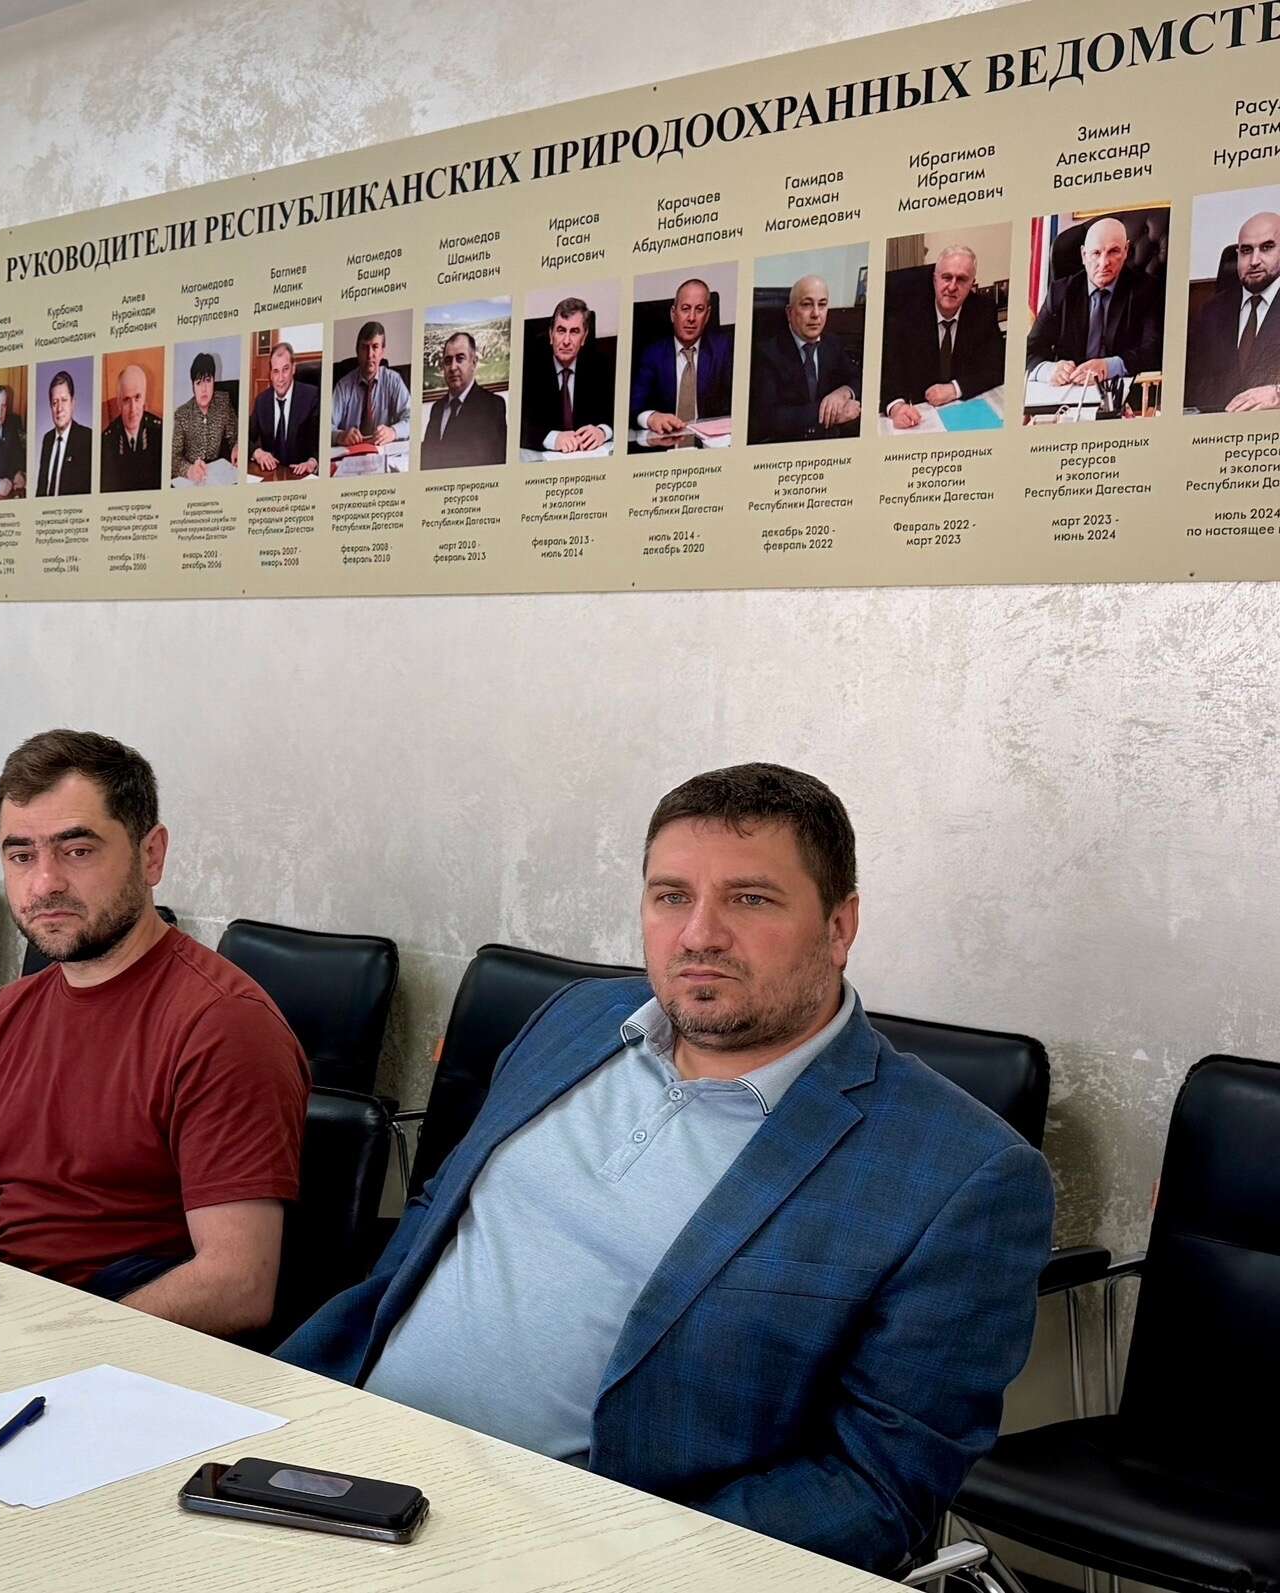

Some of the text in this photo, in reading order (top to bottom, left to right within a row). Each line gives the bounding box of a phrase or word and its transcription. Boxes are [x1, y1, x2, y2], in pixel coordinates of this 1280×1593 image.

[1235, 98, 1280, 116] Расу
[1077, 122, 1131, 142] Зимин
[909, 145, 996, 170] Ибрагимов
[1055, 141, 1151, 167] Александр
[6, 219, 197, 282] РУКОВОДИТЕЛИ
[205, 151, 520, 243] РЕСПУБЛИКАНСКИХ
[532, 60, 970, 179] ПРИРОДООХРАННЫХ
[916, 168, 986, 189] Ибрагим
[1053, 163, 1152, 189] Васильевич
[784, 170, 844, 190] Гамидов
[656, 191, 721, 213] Карачаев
[787, 191, 840, 209] Рахман
[897, 186, 1004, 212] Магомедович
[548, 212, 600, 233] Идрисов
[657, 211, 719, 231] Набиюла
[764, 208, 861, 233] Магомедович
[438, 230, 501, 250] Магомедов
[555, 232, 591, 248] Гасан
[631, 226, 744, 254] Абдулманапович
[345, 247, 403, 266] Магомедов
[447, 250, 492, 266] Шамиль
[540, 248, 605, 270] Идрисович
[356, 266, 391, 281] Башир
[436, 265, 501, 285] Сайгидович
[180, 277, 235, 294] Магомедова
[272, 281, 304, 295] Малик
[340, 281, 408, 301] Ибрагимович
[193, 295, 220, 311] Зухра
[252, 294, 323, 316] Джамединович
[176, 308, 240, 327] Насруллаевна
[1029, 437, 1150, 455] министр природных
[1191, 431, 1280, 447] министр прир
[883, 447, 993, 463] министр природных
[1059, 455, 1117, 470] ресурсов
[1224, 447, 1278, 462] ресурсо
[752, 456, 852, 472] министр природных
[911, 464, 963, 478] ресурсов
[1219, 466, 1227, 475] и
[632, 465, 723, 480] министр природных
[777, 472, 825, 486] ресурсов
[1055, 470, 1120, 482] и экологии
[654, 480, 698, 494] ресурсов
[773, 486, 828, 497] и экологии
[907, 478, 966, 489] и экологии
[1185, 477, 1260, 494] Республики
[658, 493, 700, 504] экологии
[878, 490, 994, 507] Республики Дагестан
[1024, 483, 1152, 501] Республики Дагестан
[628, 504, 724, 520] Республики Дагестан
[747, 497, 853, 513] Республики Дагестан
[1051, 513, 1112, 529] март 2023
[1214, 511, 1247, 520] июль
[761, 524, 830, 539] декабрь 2020
[892, 518, 970, 534] Февраль 2022
[1186, 525, 1275, 537] по настоящее
[648, 530, 695, 542] июль 2014
[905, 533, 962, 549] март 2023
[1053, 528, 1116, 541] июнь 2024
[642, 542, 705, 557] декабрь 2020
[762, 537, 833, 554] февраль 2022
